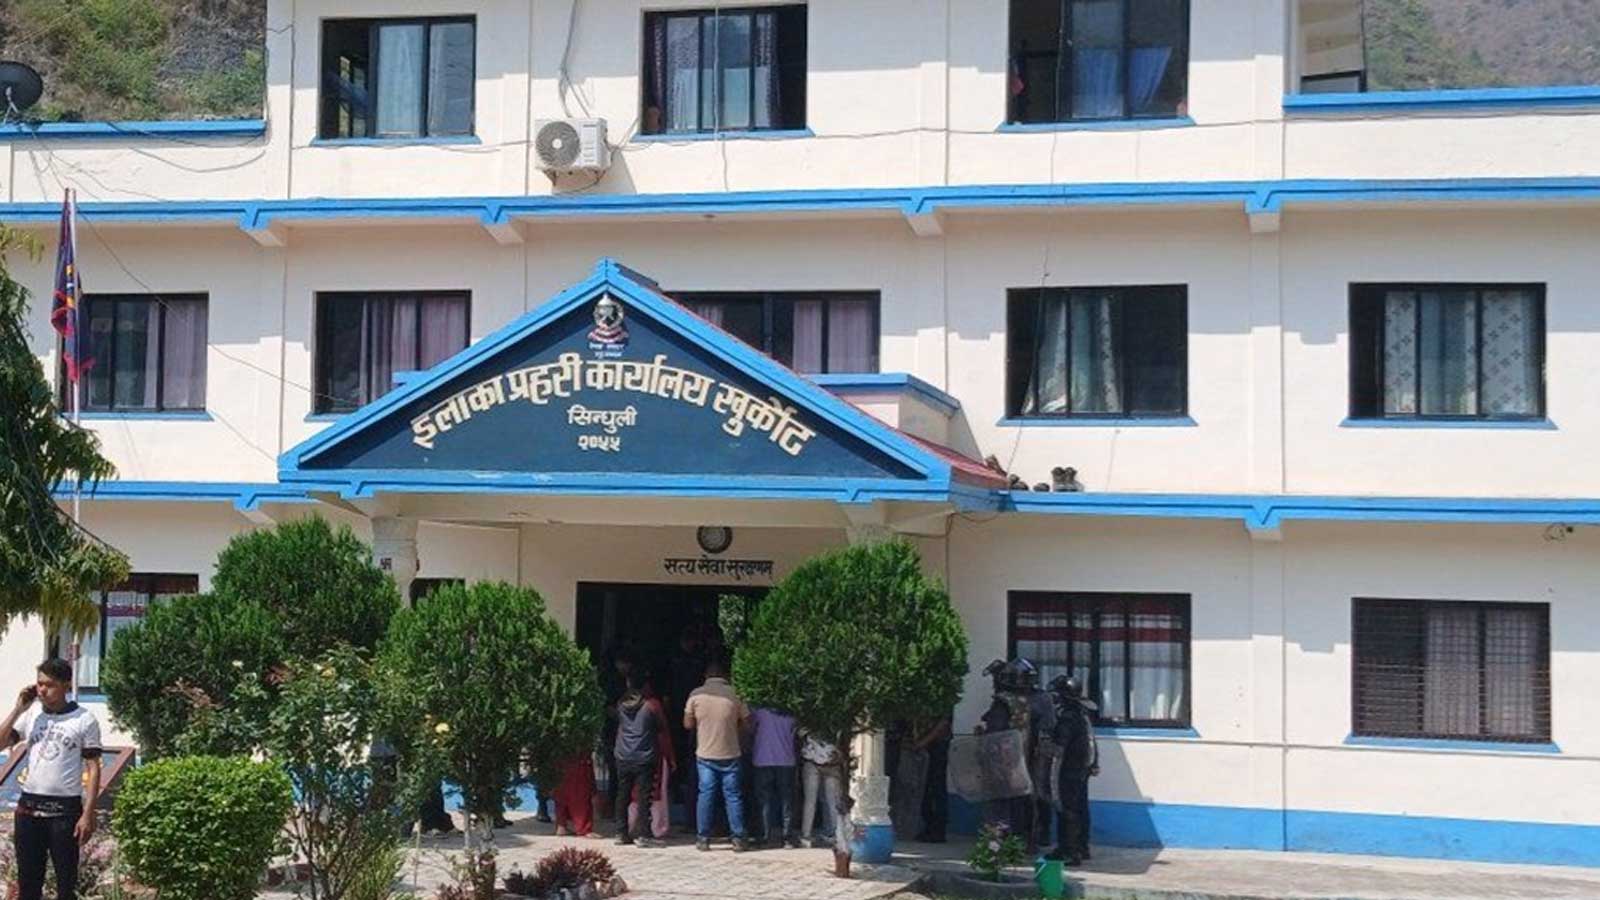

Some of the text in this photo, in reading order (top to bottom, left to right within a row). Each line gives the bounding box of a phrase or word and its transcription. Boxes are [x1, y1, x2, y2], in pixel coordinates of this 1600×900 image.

[410, 374, 506, 449] इलाका
[506, 352, 583, 404] प्रहरी
[585, 354, 716, 407] कार्यालय
[566, 404, 638, 434] सिन्धुली
[664, 558, 697, 575] सत्य
[697, 554, 725, 575] सेवा
